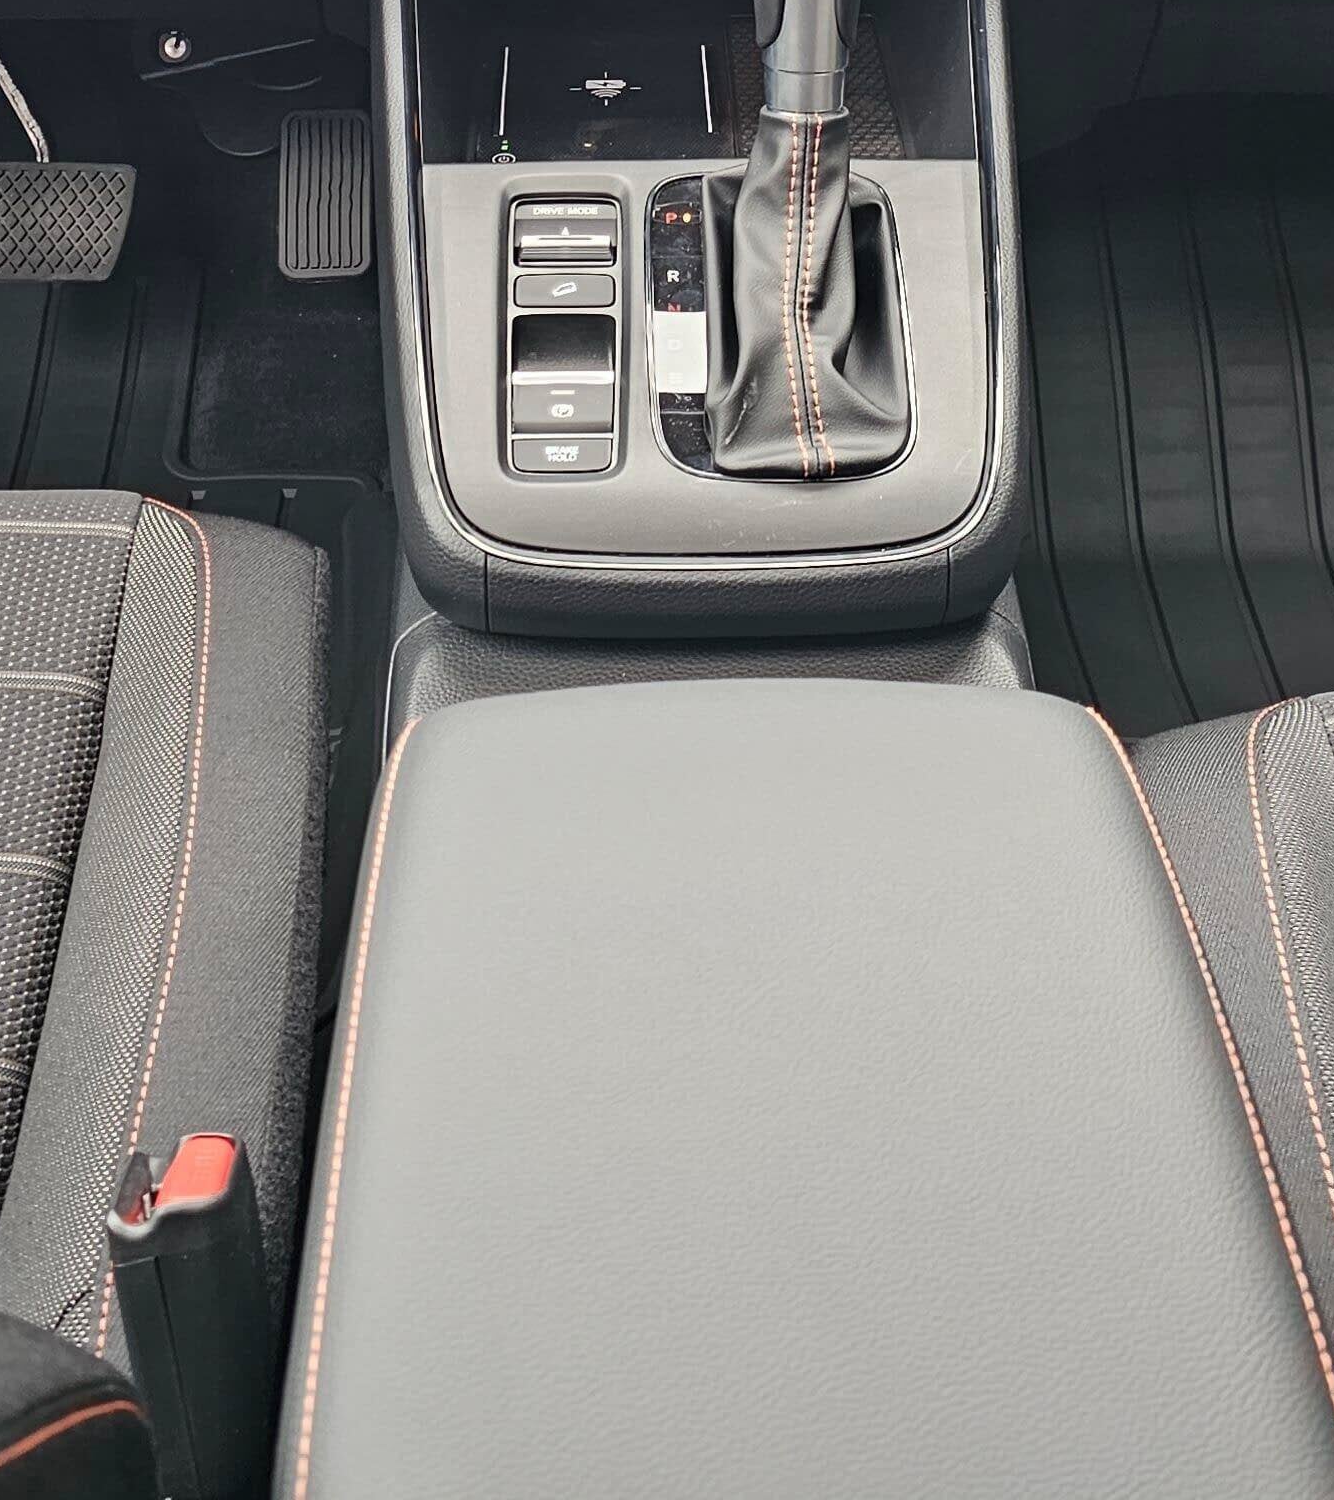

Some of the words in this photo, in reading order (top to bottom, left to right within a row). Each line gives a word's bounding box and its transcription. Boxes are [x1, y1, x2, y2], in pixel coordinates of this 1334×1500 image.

[533, 206, 565, 216] DRIVE
[567, 206, 599, 216] MODE
[666, 211, 678, 225] P
[666, 269, 680, 284] R
[545, 445, 580, 455] BRAKE
[547, 454, 578, 463] HOLD
